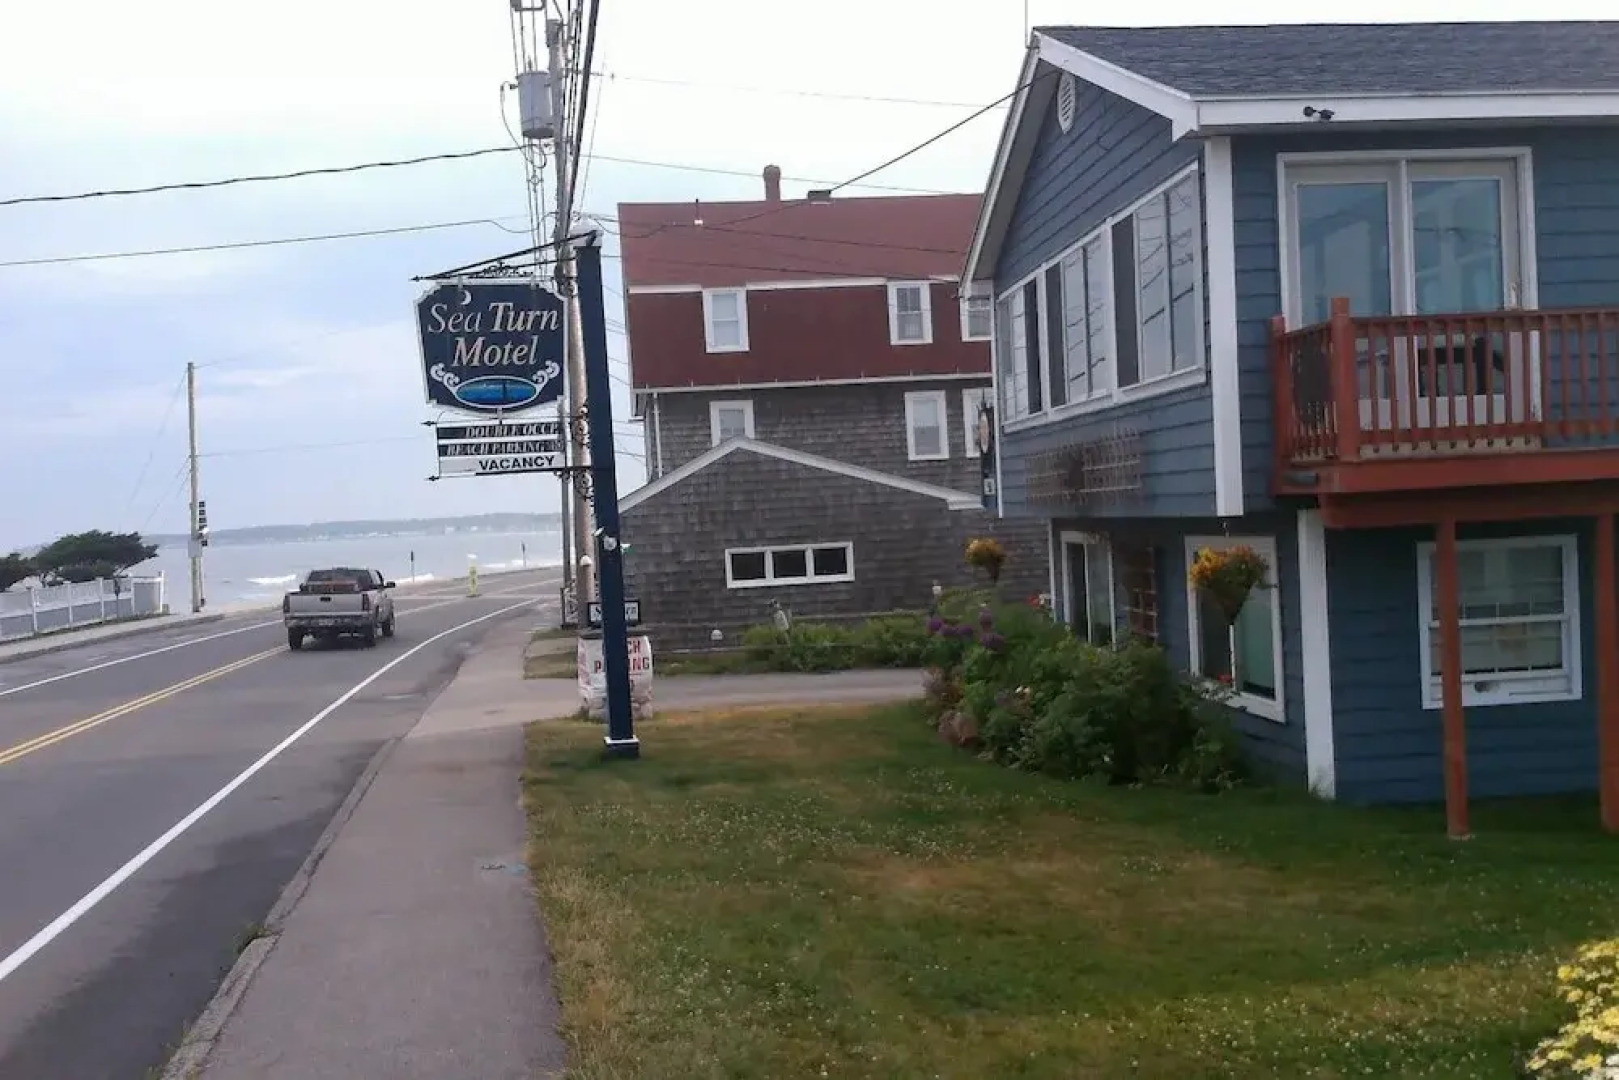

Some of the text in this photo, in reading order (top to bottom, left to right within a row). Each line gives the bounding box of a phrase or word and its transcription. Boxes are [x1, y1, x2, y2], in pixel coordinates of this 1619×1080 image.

[427, 302, 559, 333] Sea Turn
[450, 334, 539, 367] Motel
[465, 424, 519, 438] DOUBLE
[447, 441, 489, 456] BEACH
[492, 440, 545, 455] PARKING
[479, 455, 555, 471] VACANCY
